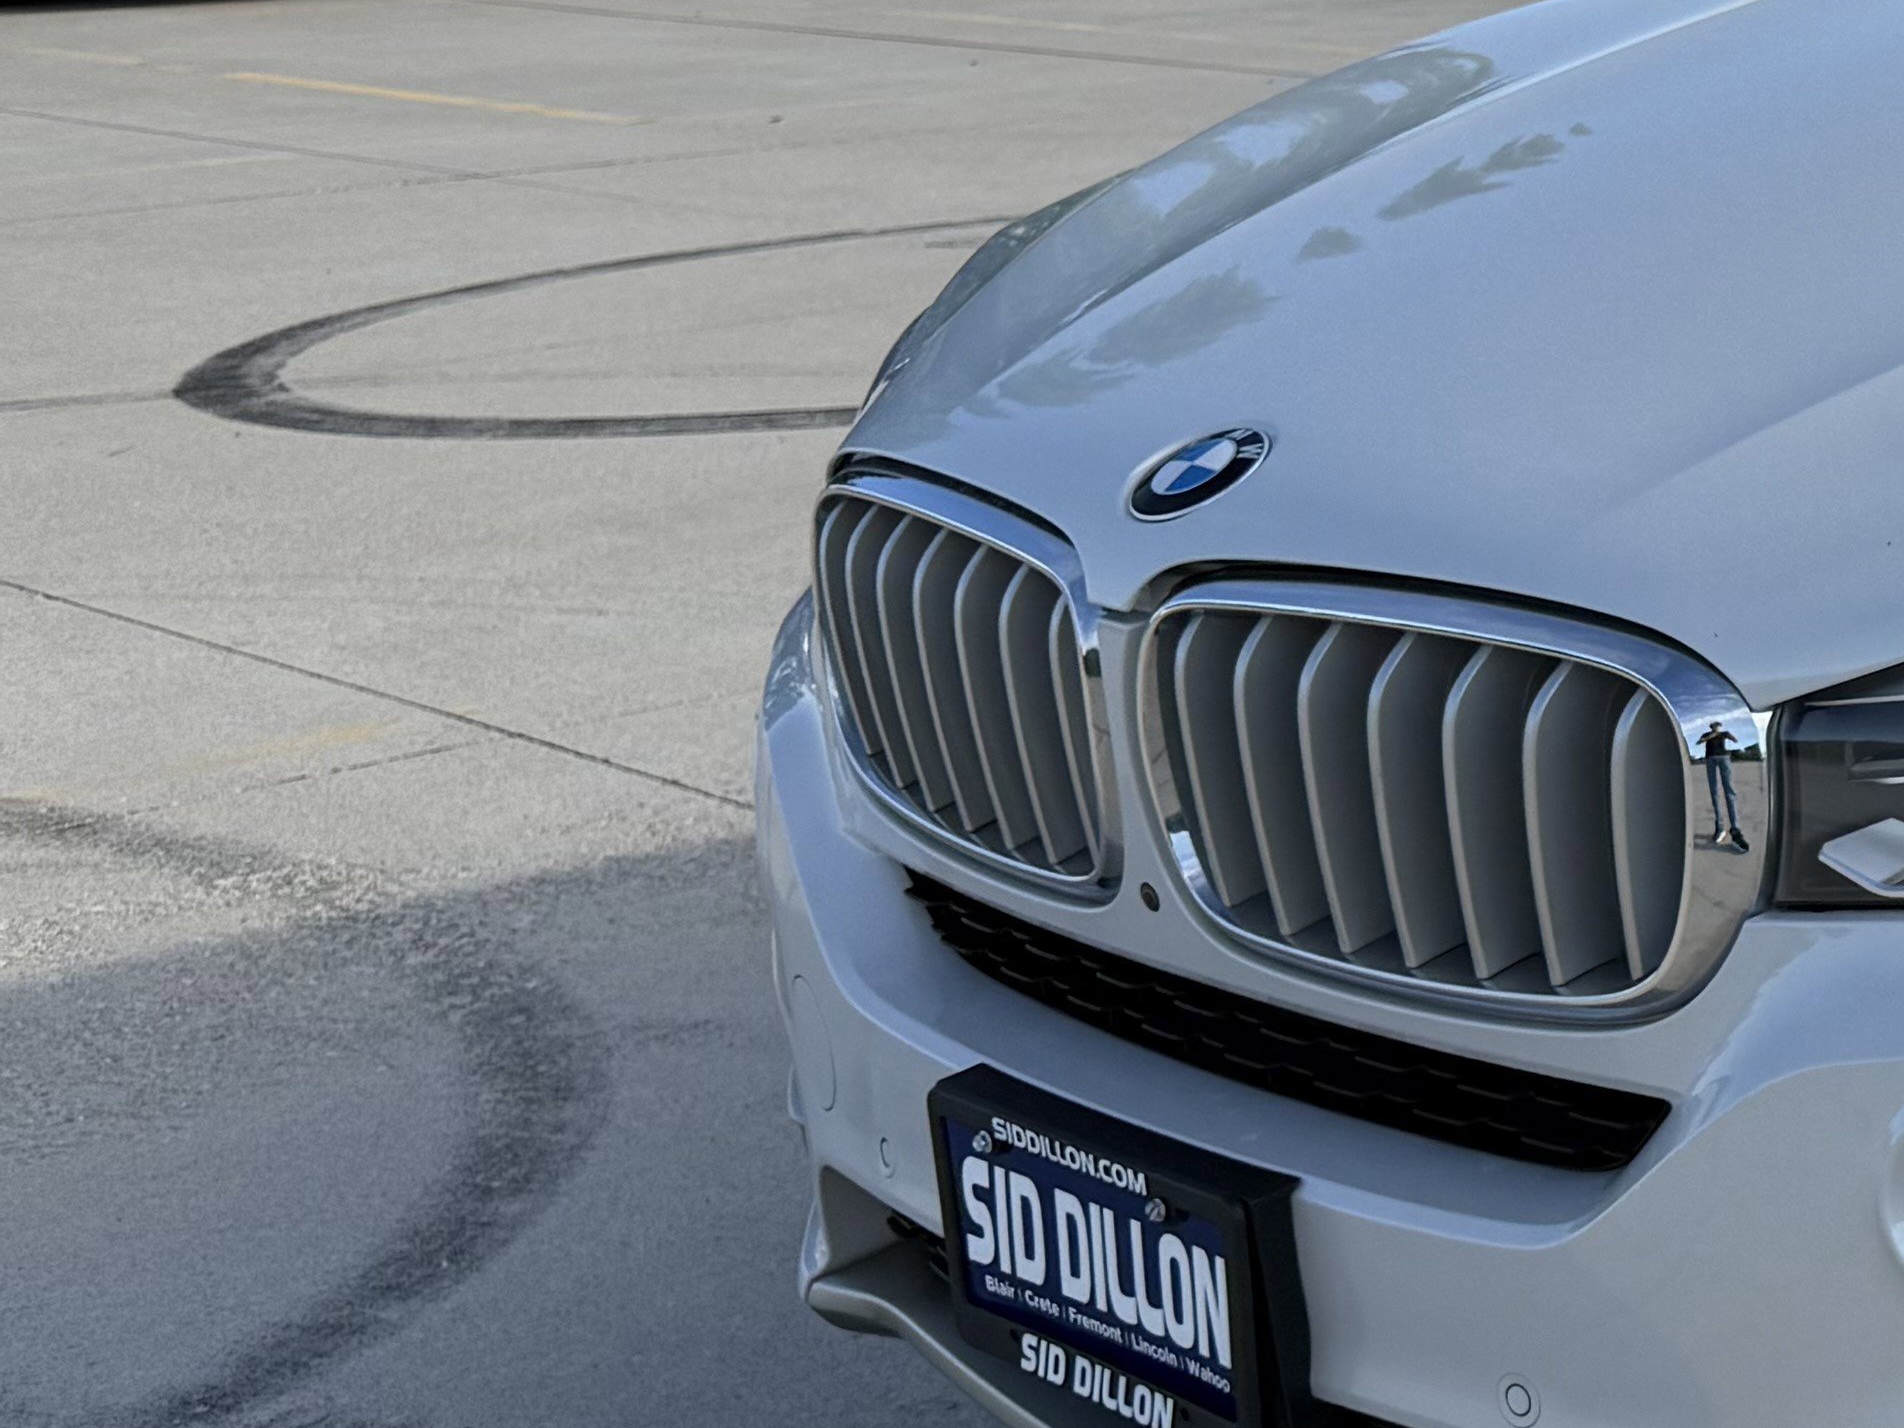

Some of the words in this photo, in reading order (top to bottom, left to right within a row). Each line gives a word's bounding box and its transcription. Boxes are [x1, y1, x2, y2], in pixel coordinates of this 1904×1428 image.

[990, 1116, 1148, 1197] SIDDILLON.COM
[961, 1155, 1046, 1286] SID
[1053, 1187, 1232, 1370] DILLON
[984, 1274, 1016, 1299] Blair
[1024, 1290, 1060, 1318] Crete
[1067, 1306, 1123, 1345] Fremont
[1130, 1332, 1178, 1368] Lincoln
[1185, 1356, 1232, 1394] Wahoo
[1020, 1331, 1067, 1387] SID
